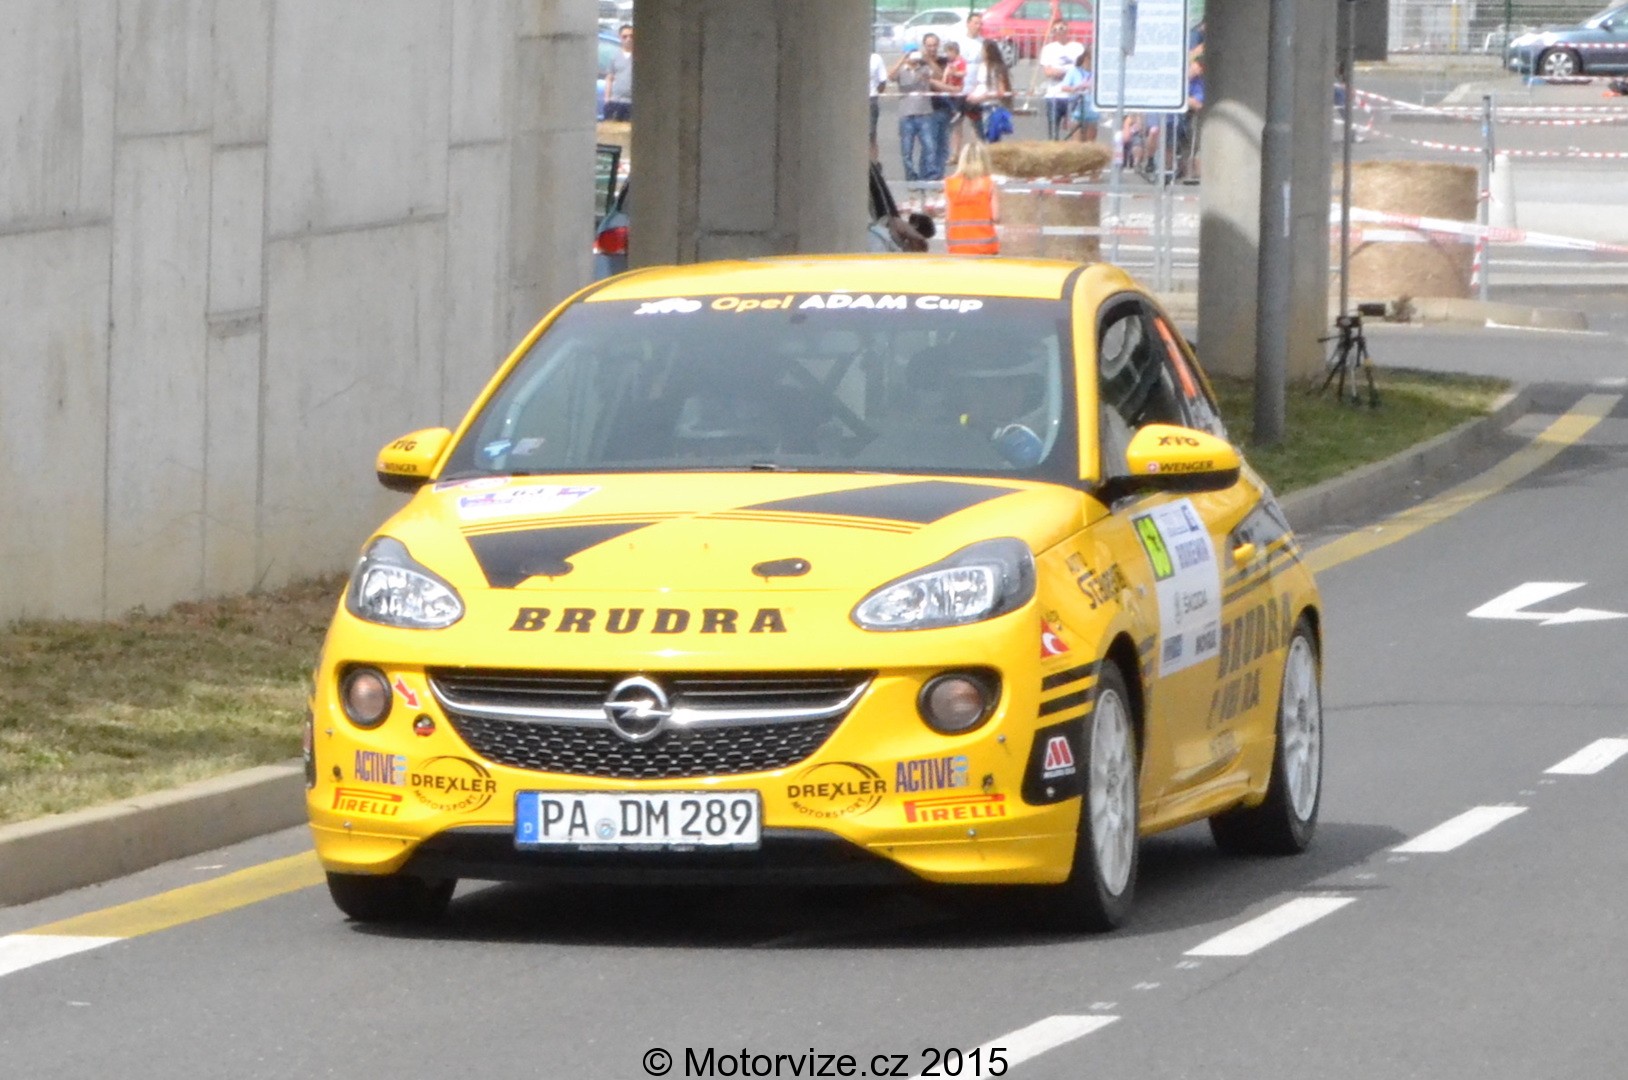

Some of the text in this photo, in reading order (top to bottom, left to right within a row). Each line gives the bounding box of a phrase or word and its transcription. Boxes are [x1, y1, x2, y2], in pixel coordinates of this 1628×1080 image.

[711, 295, 795, 312] Opel
[799, 294, 908, 310] ADAM
[915, 295, 985, 313] Cup
[1160, 460, 1214, 473] WENGER
[509, 606, 788, 634] BRUDRA
[355, 749, 398, 785] ACTIVE
[895, 756, 957, 793] ACTIVE
[411, 773, 497, 794] DREXLER
[787, 779, 887, 801] DREXLER
[332, 787, 403, 816] PIRELLI
[903, 794, 1006, 823] PIRELLI
[541, 799, 753, 837] PA DM 289
